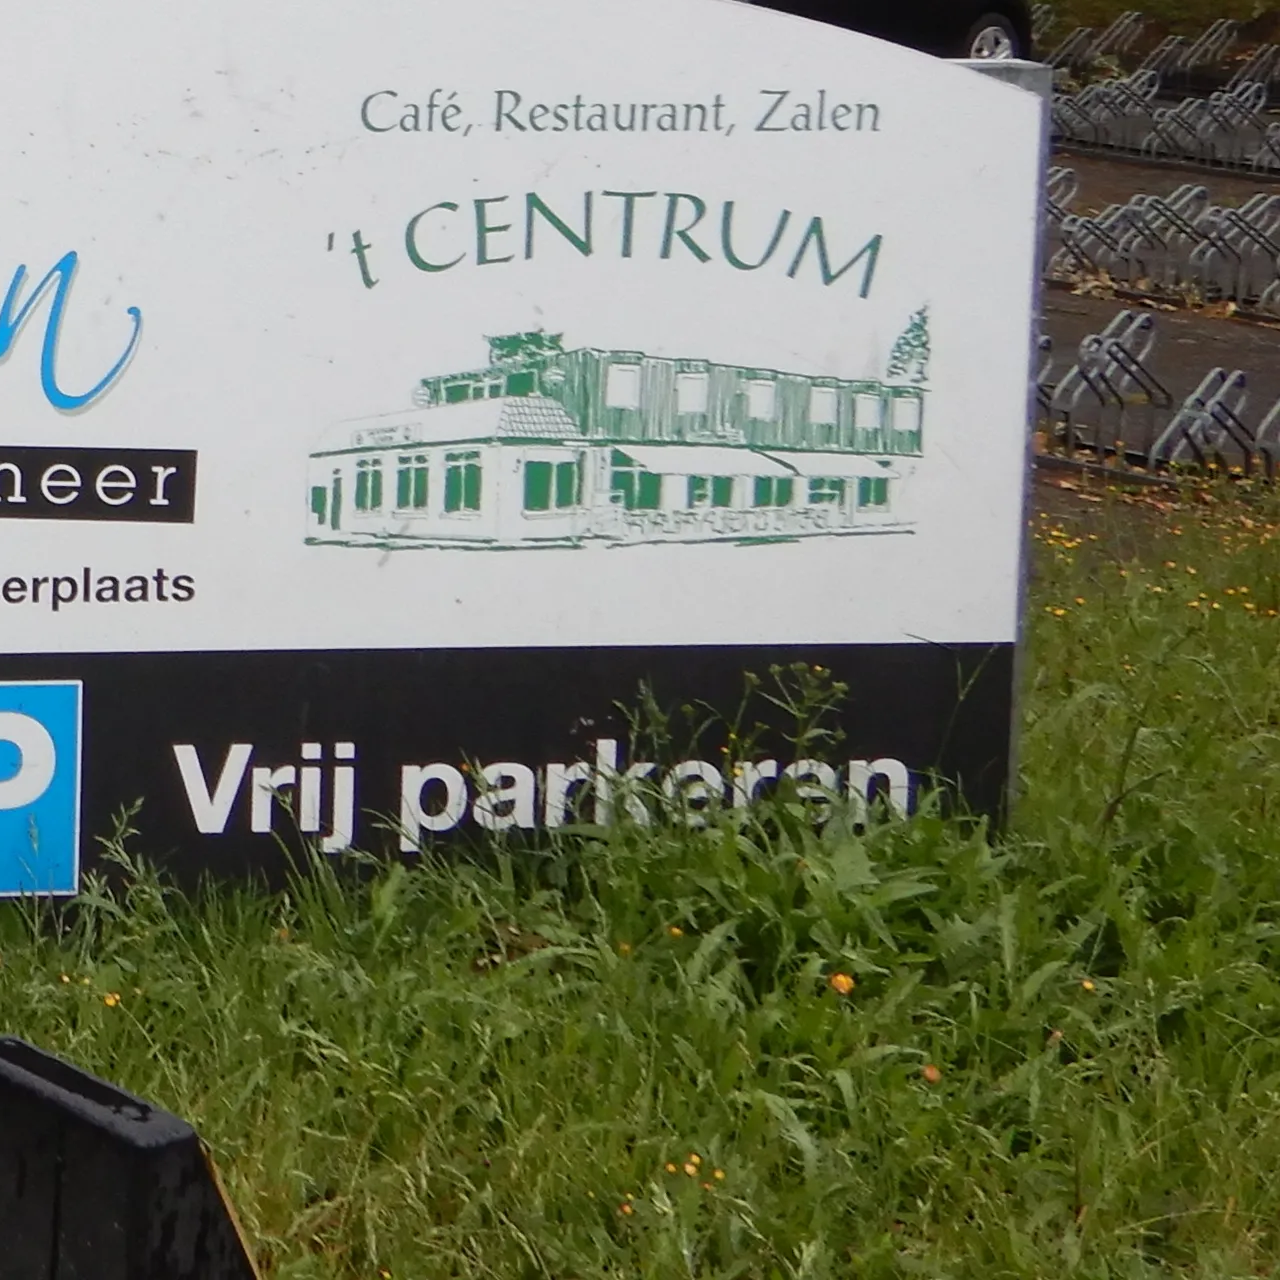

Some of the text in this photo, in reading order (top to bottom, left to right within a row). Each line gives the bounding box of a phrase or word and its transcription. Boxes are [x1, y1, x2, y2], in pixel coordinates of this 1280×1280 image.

[360, 88, 880, 137] Café, Restaurant, Zalen
[327, 189, 883, 300] 't CENTRUM
[173, 739, 909, 853] Vrij parkeren
